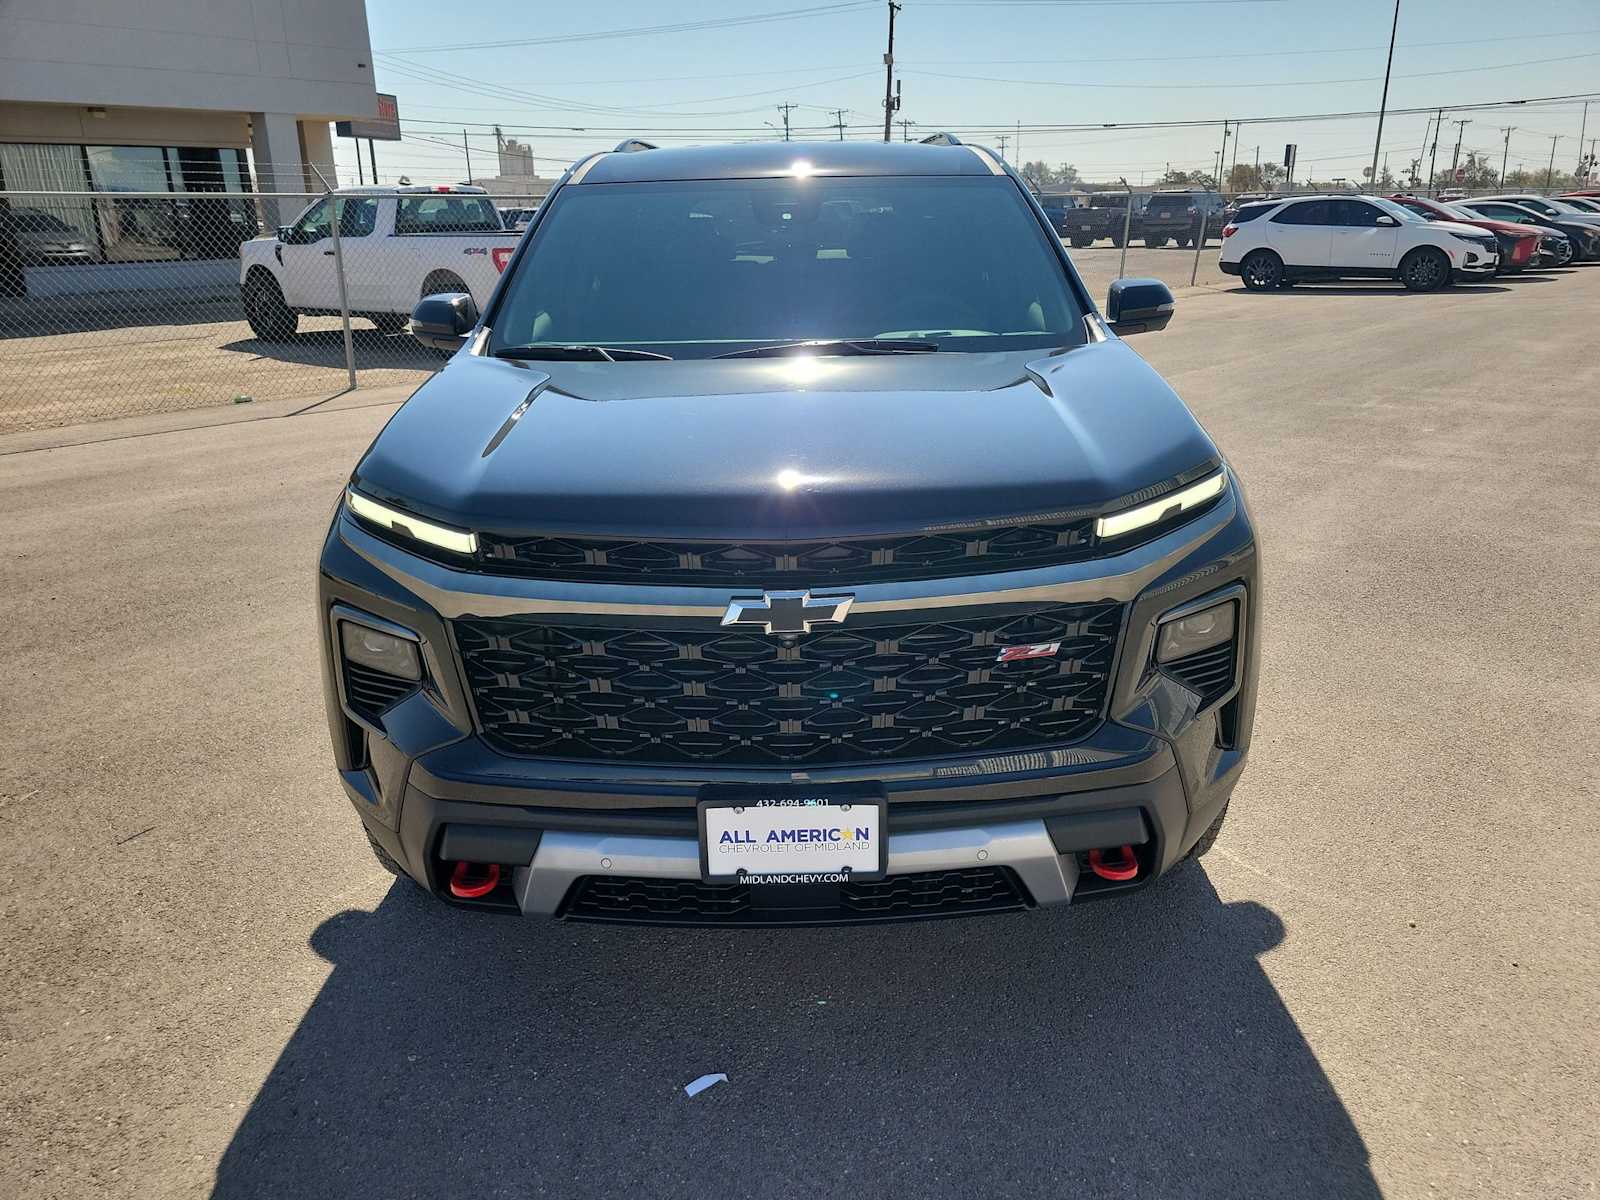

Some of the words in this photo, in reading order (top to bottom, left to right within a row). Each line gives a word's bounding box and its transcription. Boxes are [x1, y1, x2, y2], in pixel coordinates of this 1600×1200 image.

[756, 799, 829, 808] 432-694-9601
[719, 830, 757, 844] ALL
[766, 826, 869, 843] AMERICN
[719, 843, 790, 853] CHEVROLET
[795, 843, 812, 851] OF
[815, 841, 869, 851] MIDLAND
[740, 873, 849, 885] MIDLANDCHEVY.COM
